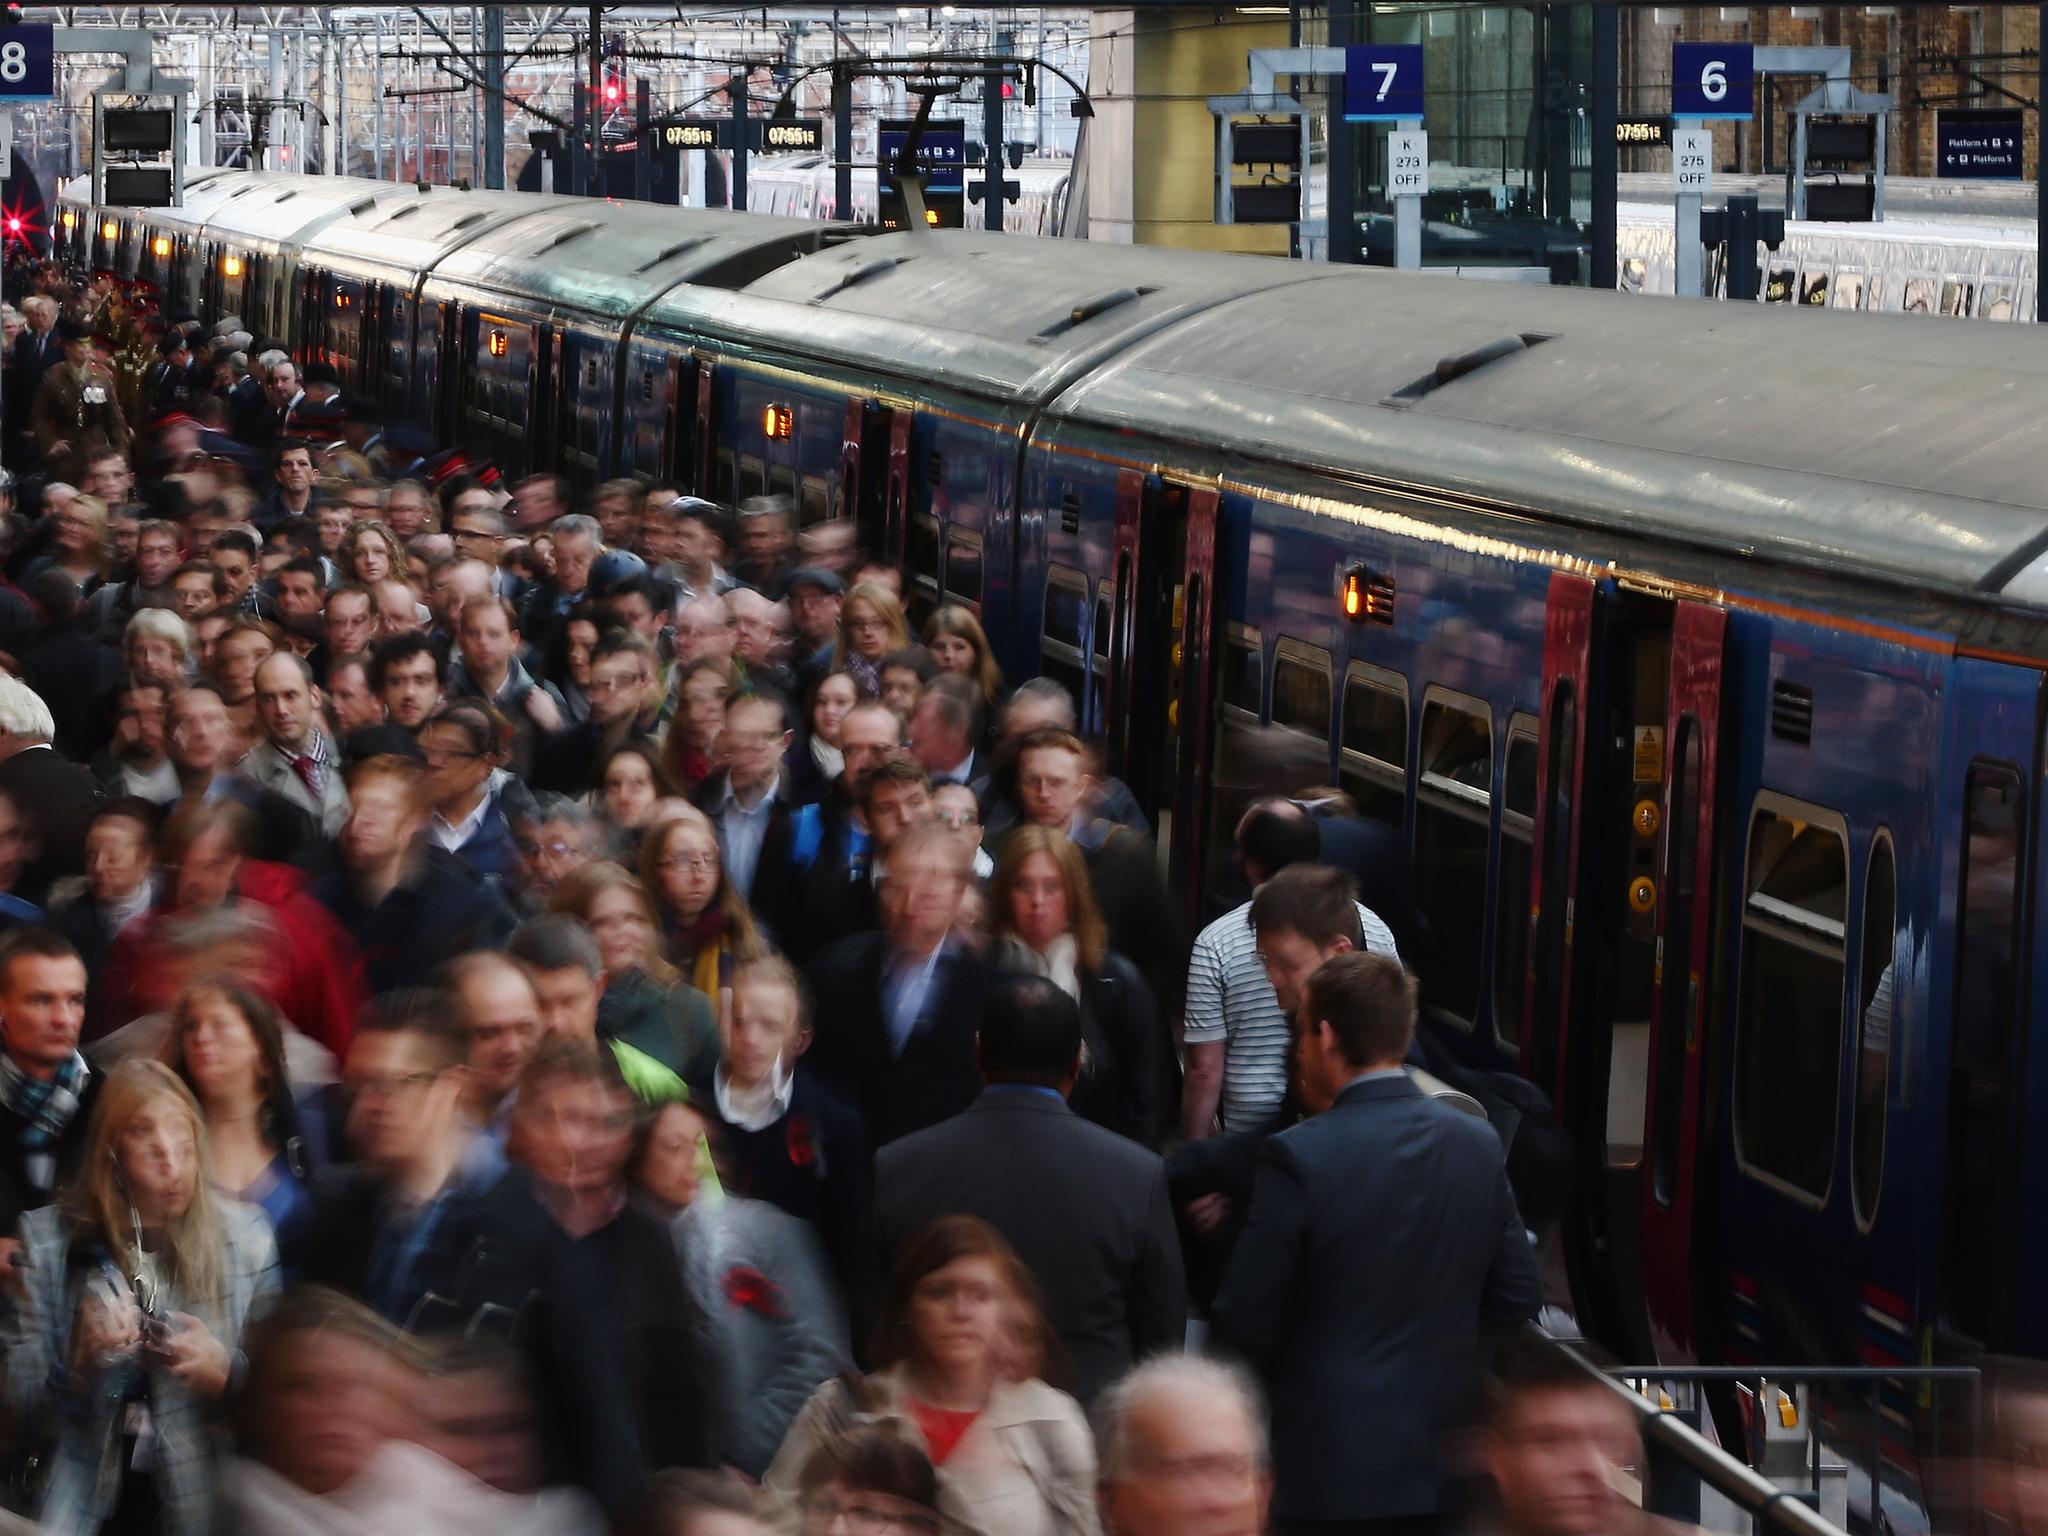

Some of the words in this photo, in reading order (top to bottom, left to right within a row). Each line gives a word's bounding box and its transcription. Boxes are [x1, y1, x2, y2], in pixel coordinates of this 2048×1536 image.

[1, 41, 27, 83] 8
[1371, 63, 1397, 102] 7
[1701, 60, 1728, 102] 6
[1403, 139, 1411, 150] K
[1687, 138, 1696, 149] K
[1949, 138, 1981, 147] Platform
[1982, 139, 1987, 147] 4
[1396, 157, 1420, 168] 273
[1680, 155, 1704, 166] 275
[1973, 154, 2005, 163] Platform
[1395, 174, 1421, 185] OFF
[1679, 173, 1705, 184] OFF
